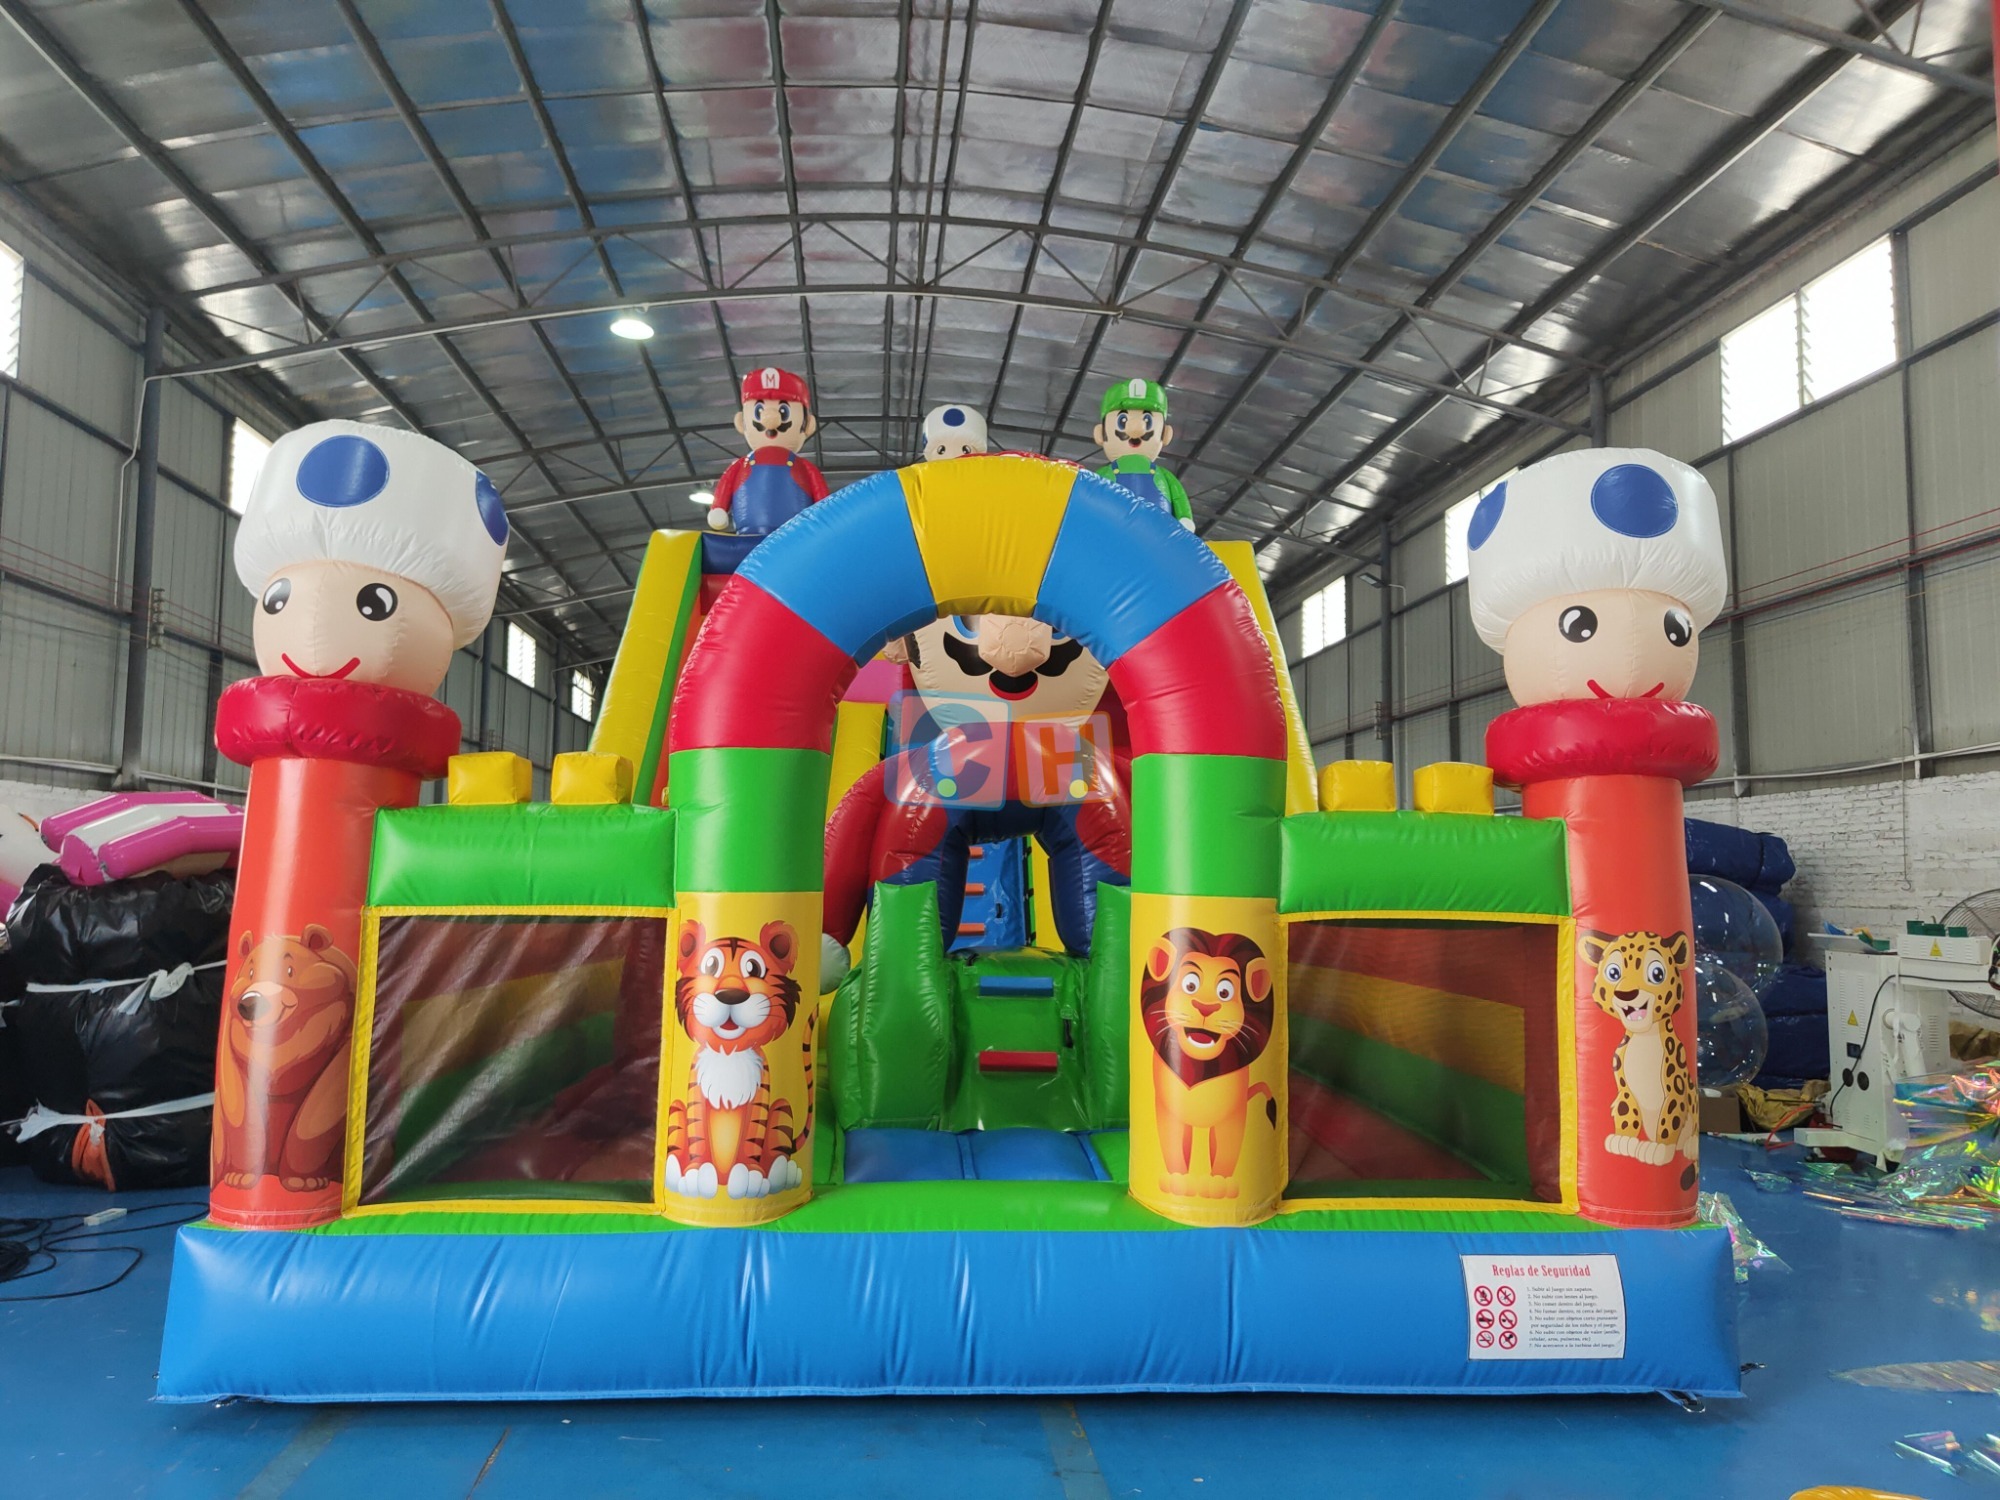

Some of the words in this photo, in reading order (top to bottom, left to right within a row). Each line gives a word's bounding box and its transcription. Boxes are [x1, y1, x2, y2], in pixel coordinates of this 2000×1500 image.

[766, 373, 775, 388] M
[1133, 383, 1143, 397] L
[1492, 1264, 1525, 1278] Reglas
[1527, 1264, 1539, 1277] de
[1541, 1264, 1591, 1278] Seguridad
